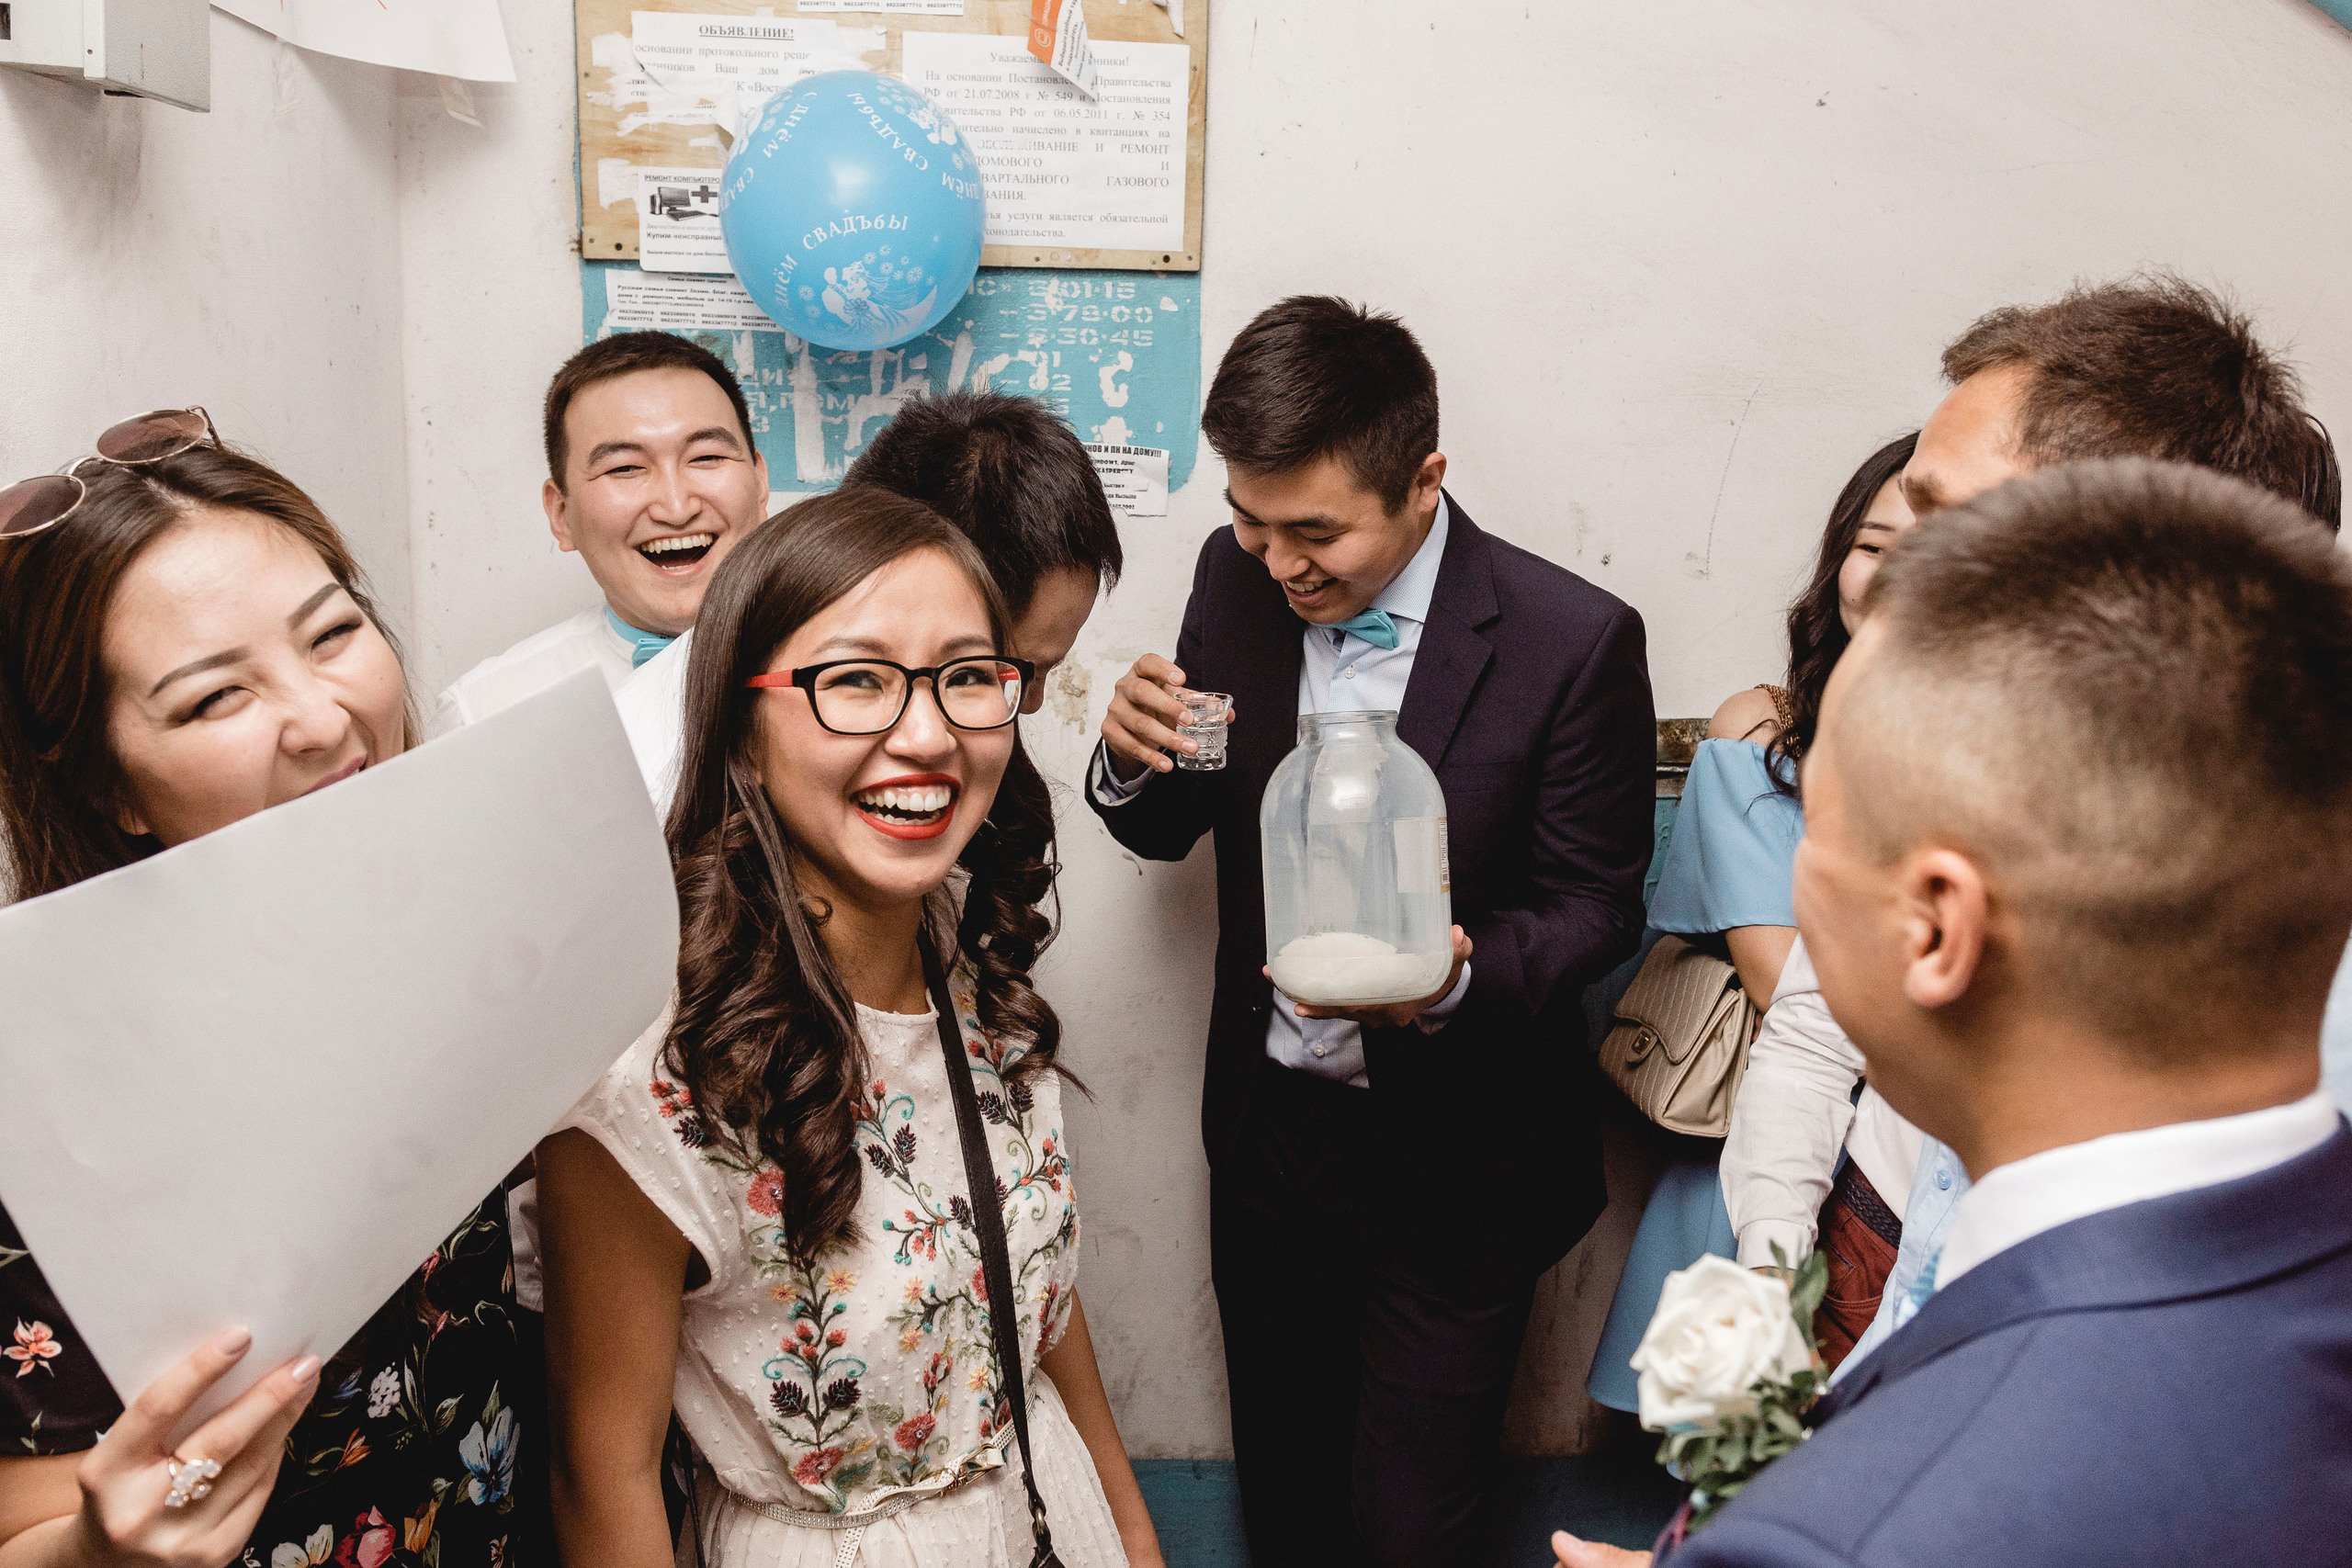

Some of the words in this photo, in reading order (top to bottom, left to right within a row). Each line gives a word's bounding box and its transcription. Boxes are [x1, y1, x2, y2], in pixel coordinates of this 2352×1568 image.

[699, 24, 795, 39] ОБЪЯВЛЕНИЕ!
[635, 45, 693, 55] основании
[698, 48, 778, 59] протокольного
[715, 63, 740, 73] Ваш
[925, 71, 940, 81] На
[946, 73, 1001, 84] основании
[1095, 75, 1172, 89] Правительства
[924, 88, 941, 99] РФ
[965, 89, 1020, 100] 21.07.2008
[1055, 91, 1073, 101] 549
[1010, 107, 1026, 118] РФ
[1054, 108, 1108, 119] 06.05.2011
[1133, 110, 1146, 120] №
[1152, 111, 1170, 121] 354
[1012, 126, 1067, 136] начислено
[1090, 129, 1149, 139] квитанциях
[1095, 142, 1103, 152] И
[1120, 143, 1170, 154] РЕМОНТ
[1160, 161, 1170, 171] И
[644, 174, 672, 182] РЕМОНТ
[1106, 176, 1170, 187] ГАЗОВОГО
[1007, 212, 1043, 223] услуги
[1049, 212, 1094, 222] является
[1100, 212, 1169, 224] обязательной
[646, 232, 672, 241] Купим
[1110, 446, 1121, 455] ПК
[1122, 446, 1132, 456] НА
[1133, 447, 1162, 458] ДОМУ!!!
